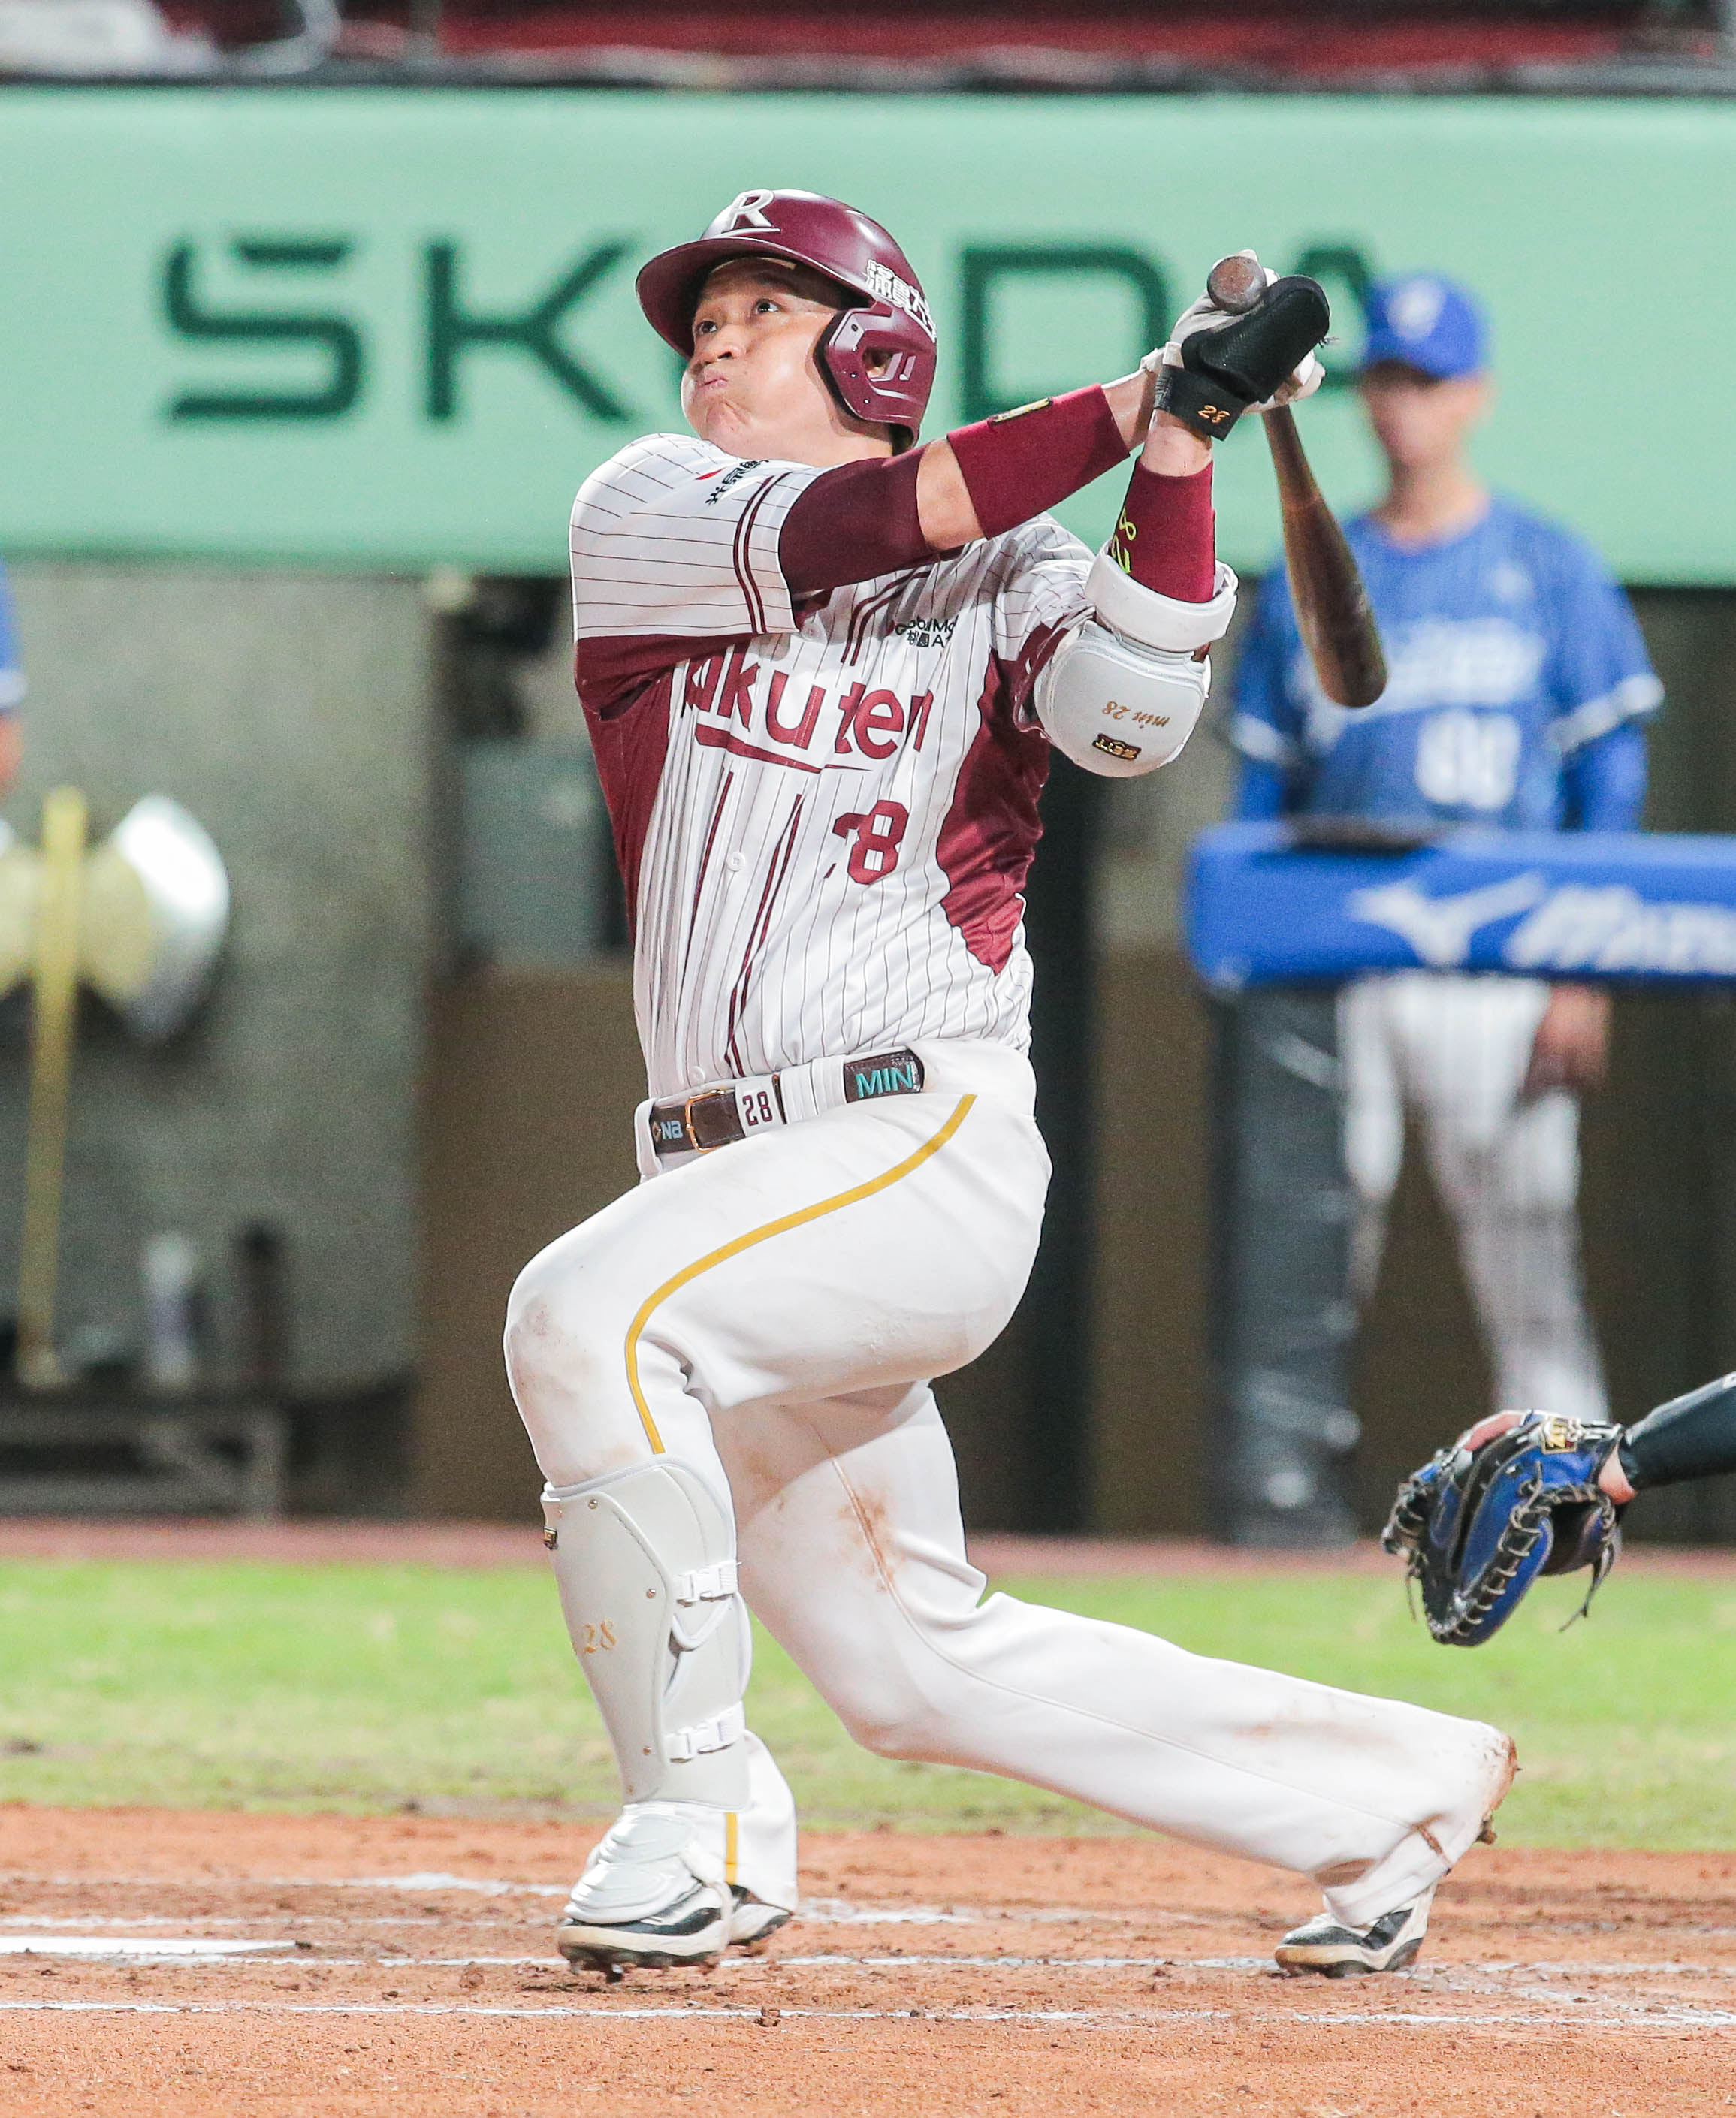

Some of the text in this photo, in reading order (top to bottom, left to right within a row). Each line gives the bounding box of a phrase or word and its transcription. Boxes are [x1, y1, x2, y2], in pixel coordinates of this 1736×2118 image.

[715, 189, 780, 234] R
[161, 231, 1378, 424] SKD
[683, 650, 934, 759] akuten
[1101, 701, 1131, 720] 28
[855, 1062, 913, 1099] MIN
[742, 1091, 773, 1127] 28
[584, 1619, 617, 1653] 28
